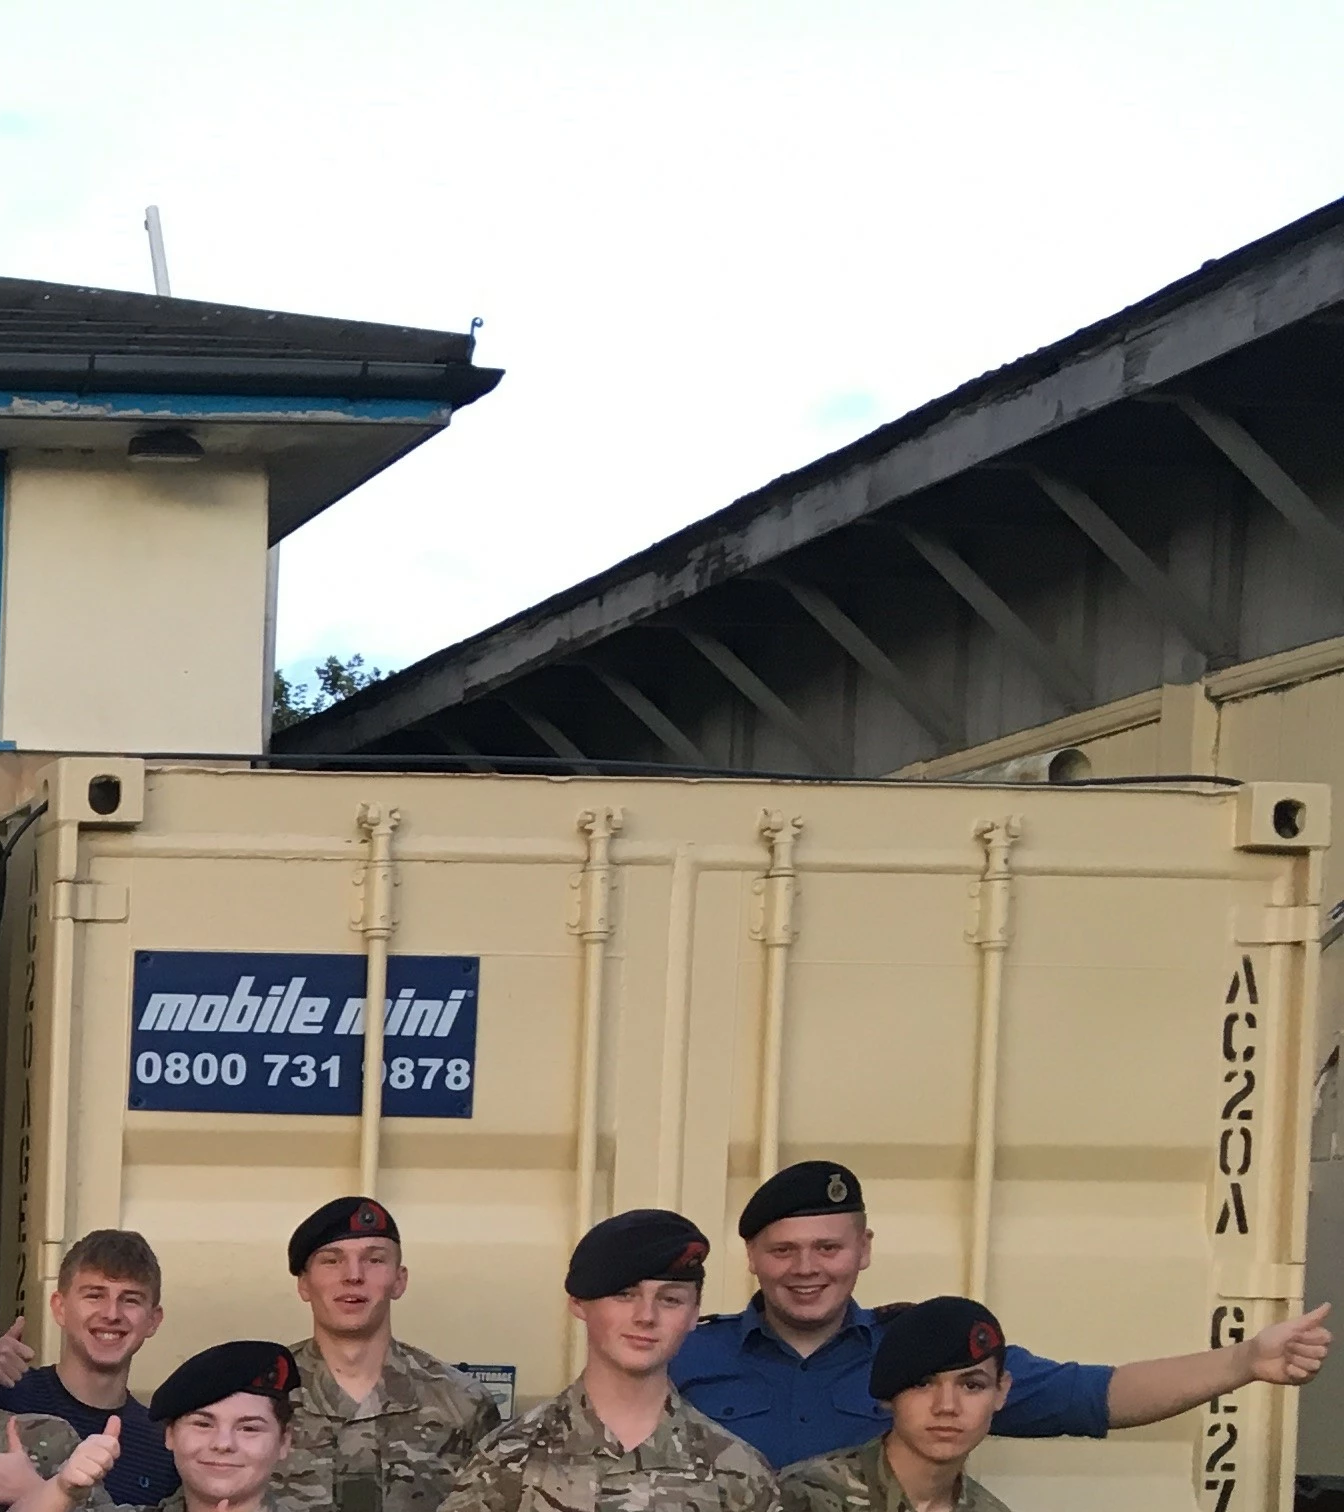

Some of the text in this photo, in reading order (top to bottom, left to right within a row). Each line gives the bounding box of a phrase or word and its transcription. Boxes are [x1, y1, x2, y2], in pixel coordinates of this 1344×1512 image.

[137, 975, 330, 1034] mobile
[135, 1051, 471, 1090] 0800 731 878
